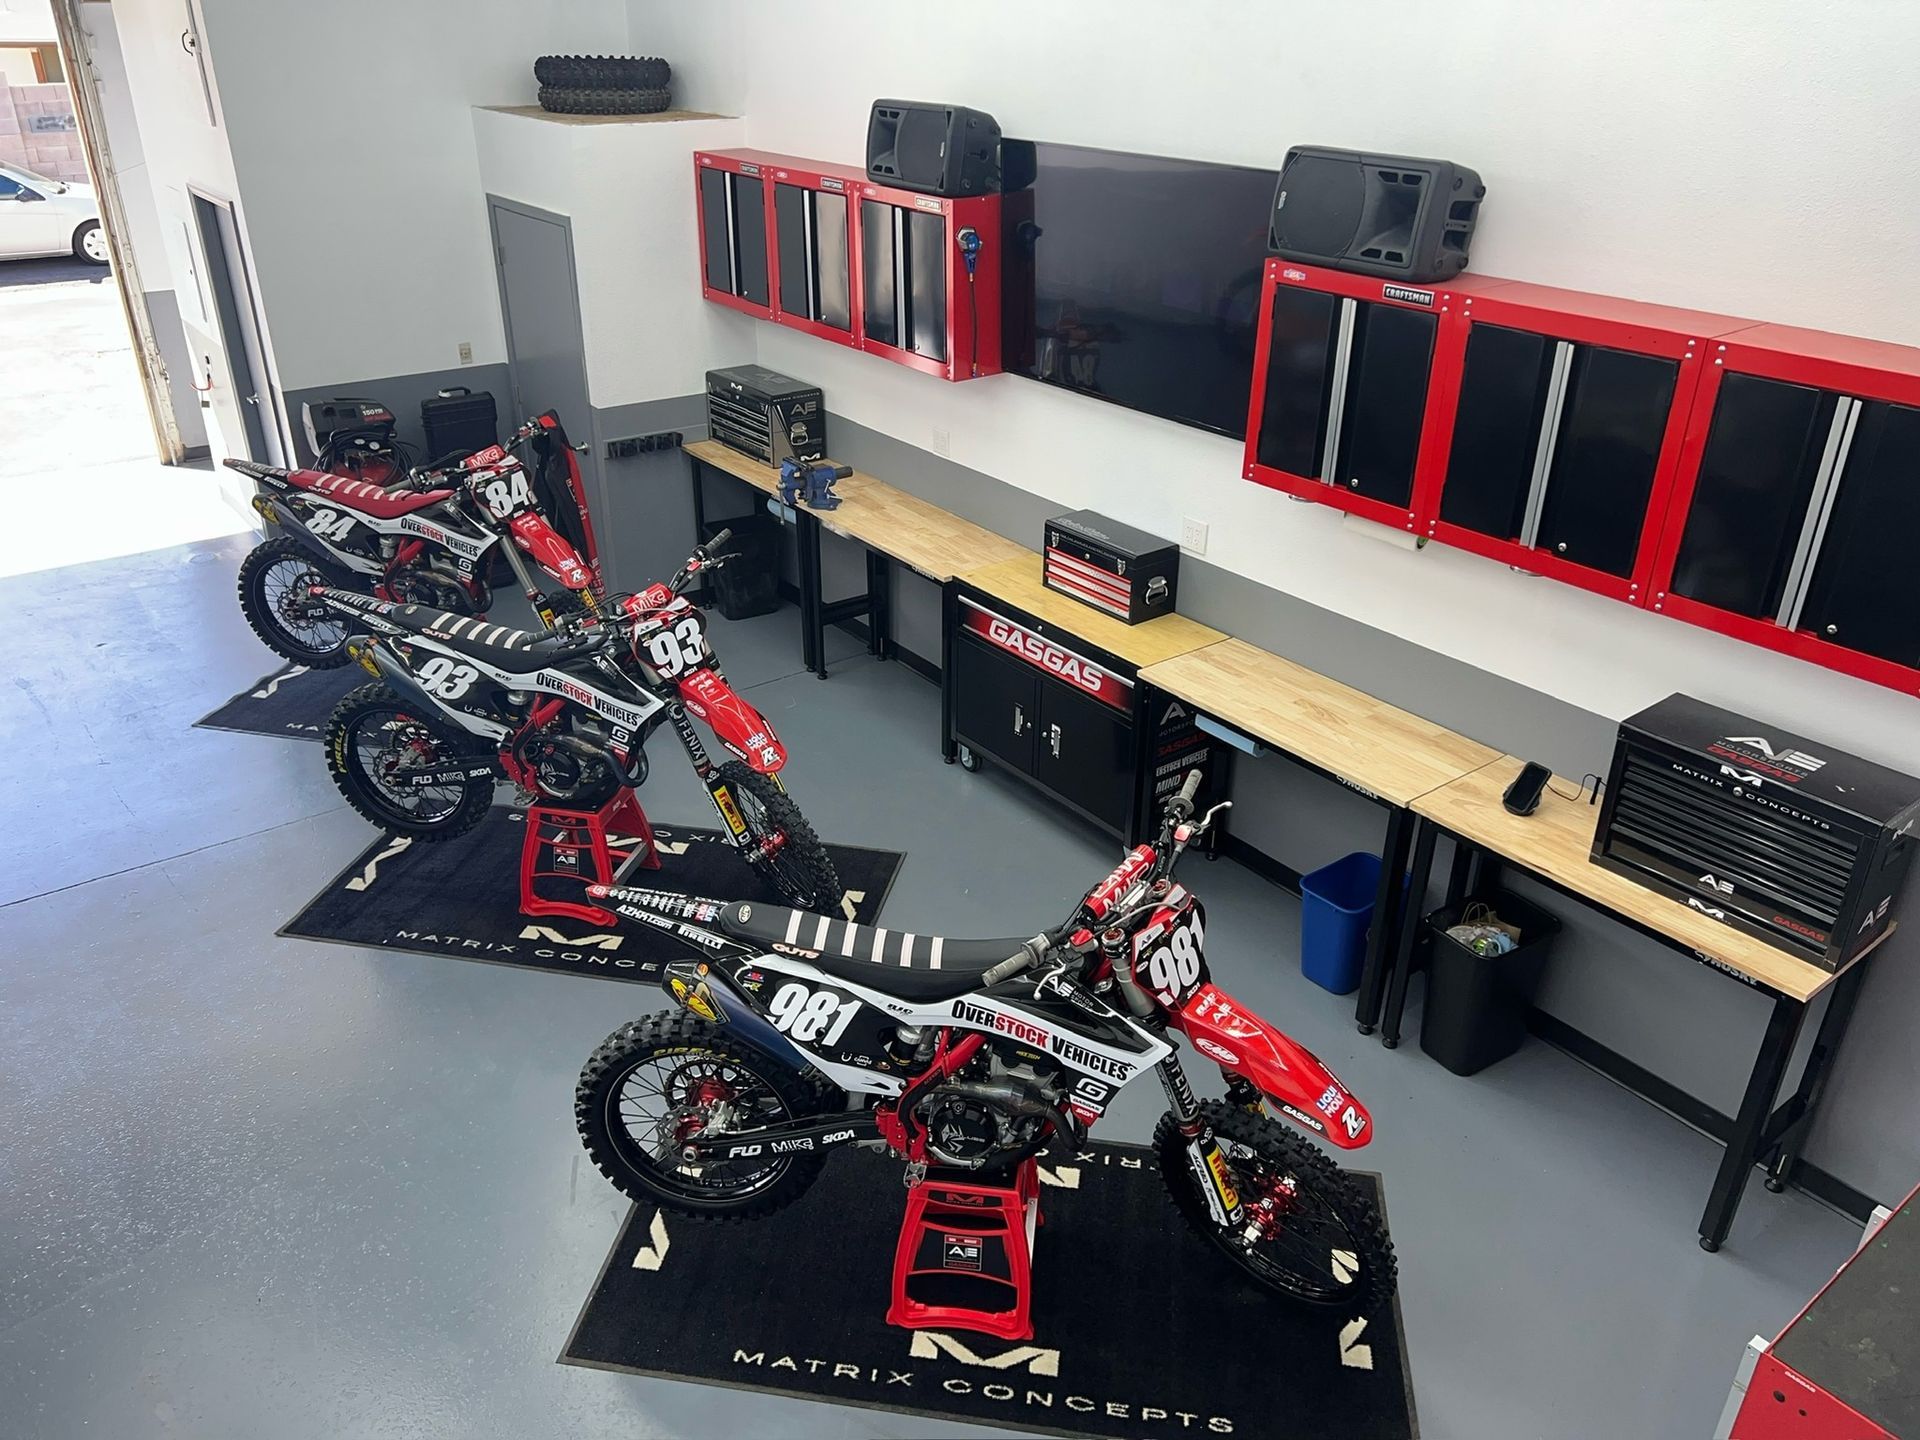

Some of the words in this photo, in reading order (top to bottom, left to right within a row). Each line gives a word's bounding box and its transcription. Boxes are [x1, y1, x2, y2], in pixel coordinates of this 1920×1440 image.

[1385, 287, 1431, 304] CRAFTSMAN
[485, 471, 529, 518] 84
[305, 508, 358, 542] 84
[400, 518, 444, 543] OVERSTOCK
[445, 534, 482, 557] VEHICLES
[649, 618, 704, 678] 93
[989, 619, 1103, 692] GASGAS
[415, 657, 480, 700] 93
[536, 672, 593, 706] OVERSTOCK
[594, 696, 643, 727] VEHICLES
[678, 718, 703, 759] FENIX
[724, 742, 748, 760] GASGAS
[412, 775, 432, 786] FLO
[1706, 744, 1802, 783] GASGAS
[1672, 763, 1724, 788] MATRIX
[1746, 792, 1831, 831] CONCEPTS
[677, 925, 724, 950] PIRELLI
[1772, 914, 1825, 943] GASGAS
[396, 930, 517, 954] MATRIX
[534, 948, 660, 972] CONCE
[772, 942, 821, 960] GUTS
[1150, 908, 1205, 1007] 981
[764, 983, 863, 1047] 981
[1073, 990, 1095, 1008] MOTOR
[951, 998, 1050, 1049] OVERSTOCK
[1052, 1034, 1138, 1082] VEHICLES
[1172, 1066, 1199, 1115] FENIX
[1316, 1085, 1337, 1111] LIQUI
[1324, 1093, 1345, 1118] MOLY
[1282, 1104, 1324, 1131] GASGAS
[729, 1144, 762, 1158] FLO
[822, 1129, 856, 1145] SKDA
[733, 1348, 914, 1386] MATRIX
[942, 1378, 1236, 1434] CONCEPTS
